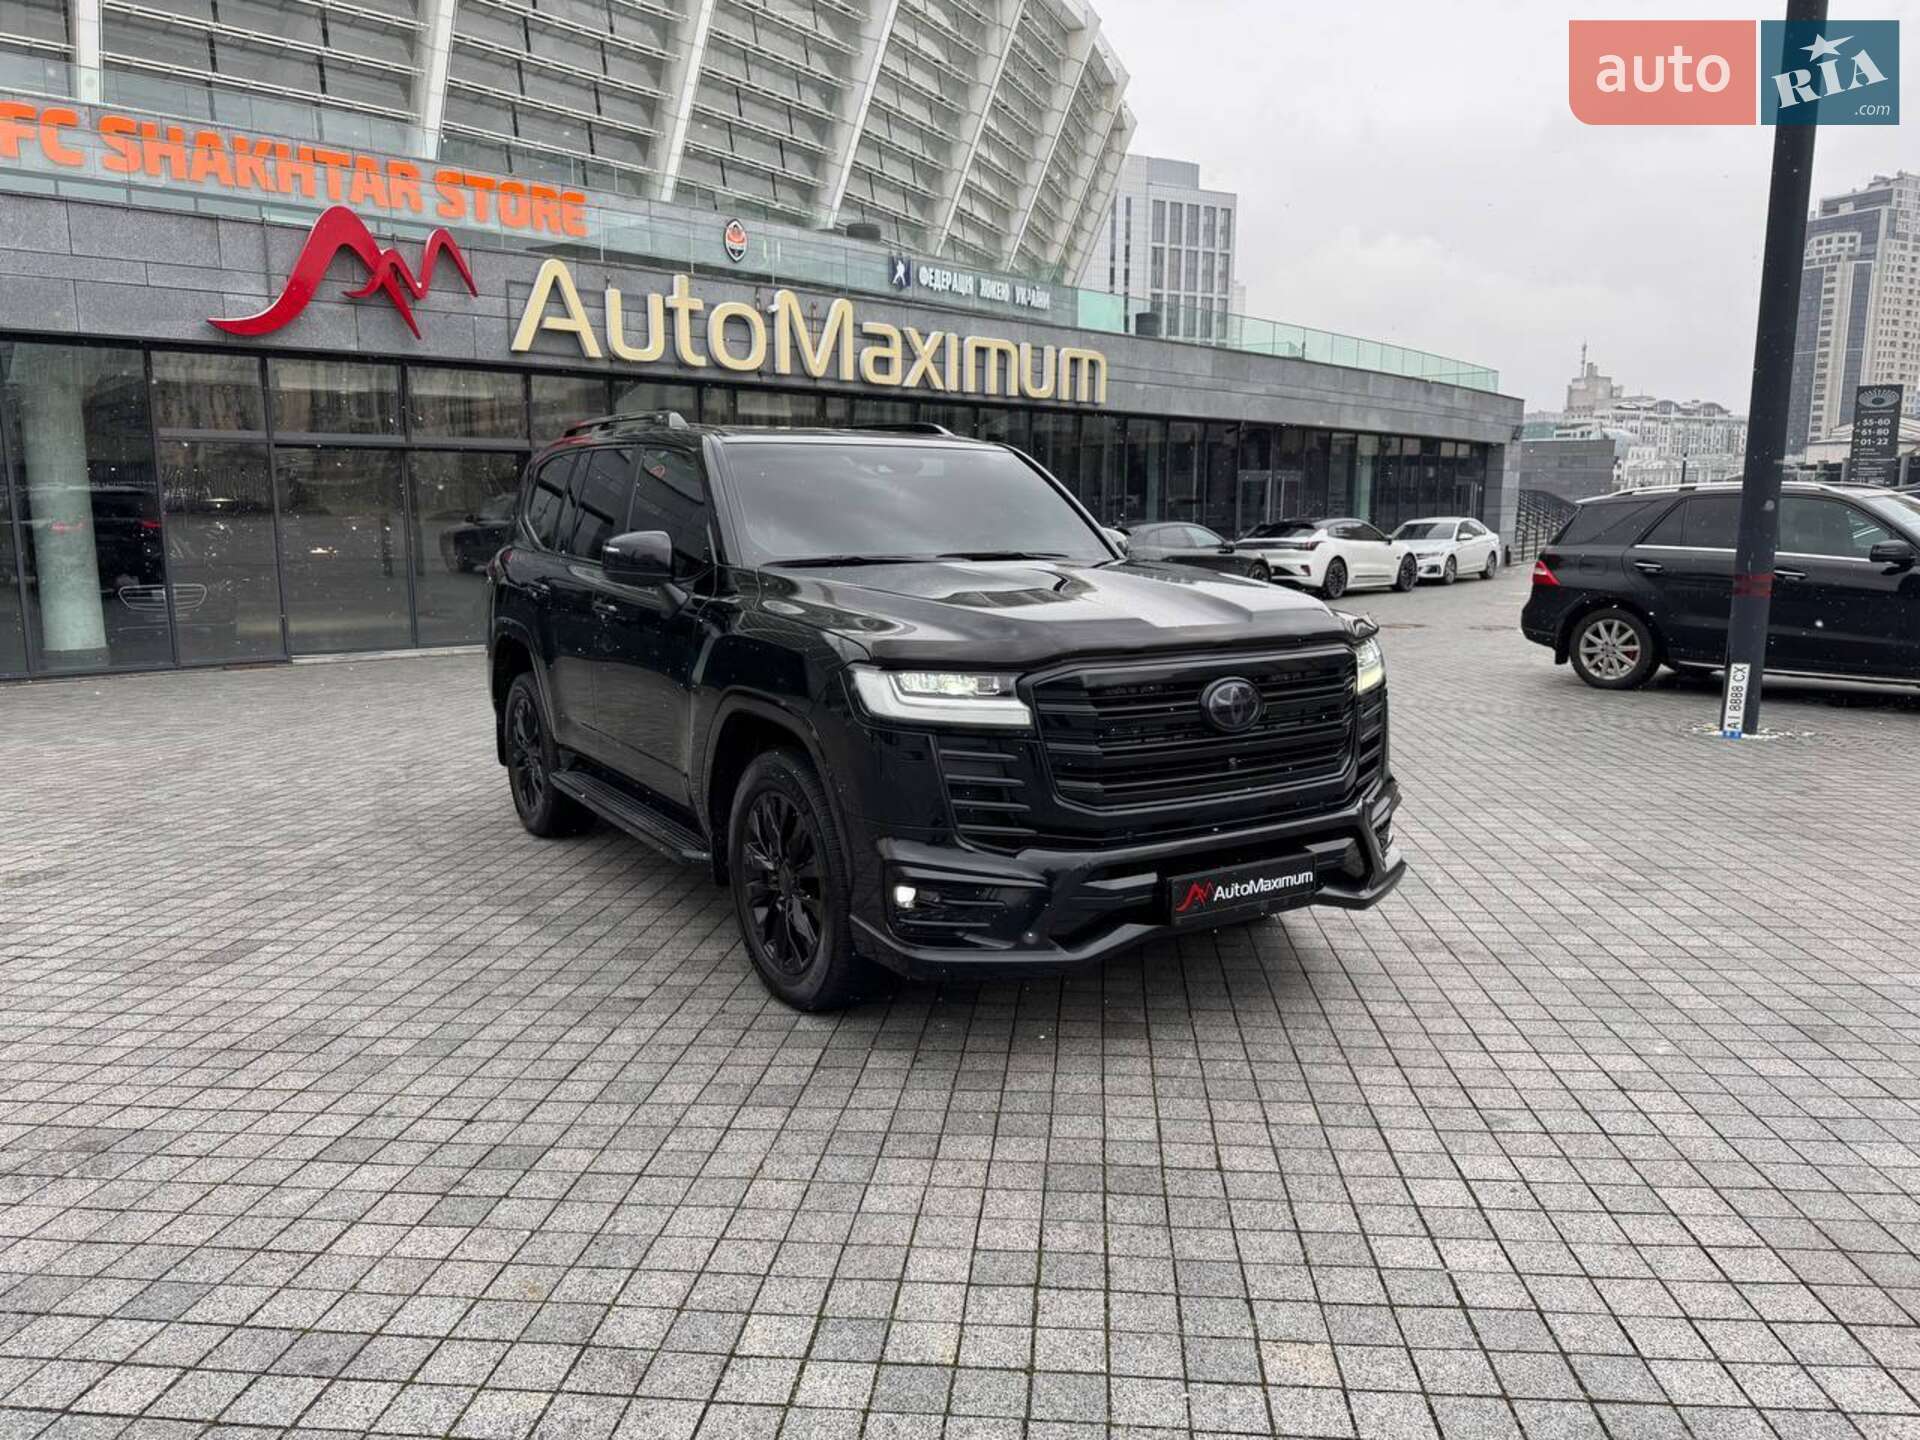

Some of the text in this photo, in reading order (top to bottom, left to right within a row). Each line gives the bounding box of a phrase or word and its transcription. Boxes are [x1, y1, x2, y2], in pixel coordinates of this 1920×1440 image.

[0, 101, 588, 237] FC SHAKHTAR STORE
[510, 258, 1107, 404] AutoMaximum
[1733, 666, 1747, 681] CX
[1729, 685, 1744, 711] 8888
[1214, 871, 1313, 901] AutoMaximum
